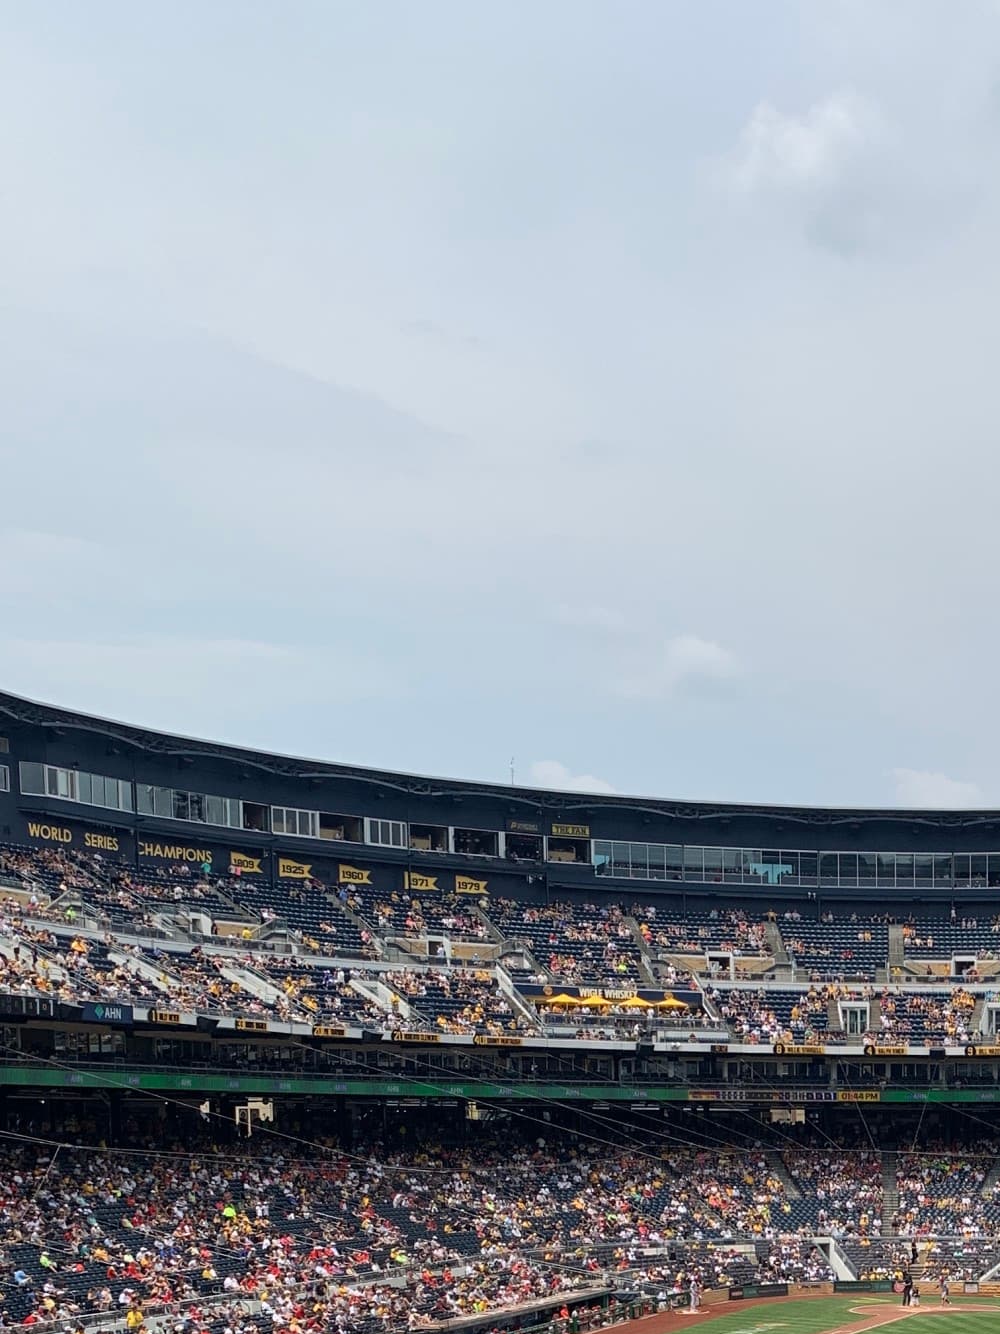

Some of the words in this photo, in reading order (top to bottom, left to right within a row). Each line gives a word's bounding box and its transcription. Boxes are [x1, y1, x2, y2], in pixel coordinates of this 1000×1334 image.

[28, 822, 72, 843] WORLD
[84, 832, 119, 851] SERIES
[138, 841, 213, 864] CHAMPIONS
[282, 864, 304, 875] 1925
[341, 870, 364, 881] 1960
[457, 881, 480, 891] 1979
[579, 987, 604, 998] WIGLE
[604, 988, 638, 999] WHISKEY
[104, 1007, 122, 1020] AHN
[841, 1092, 864, 1100] 01:44
[865, 1092, 879, 1100] PM
